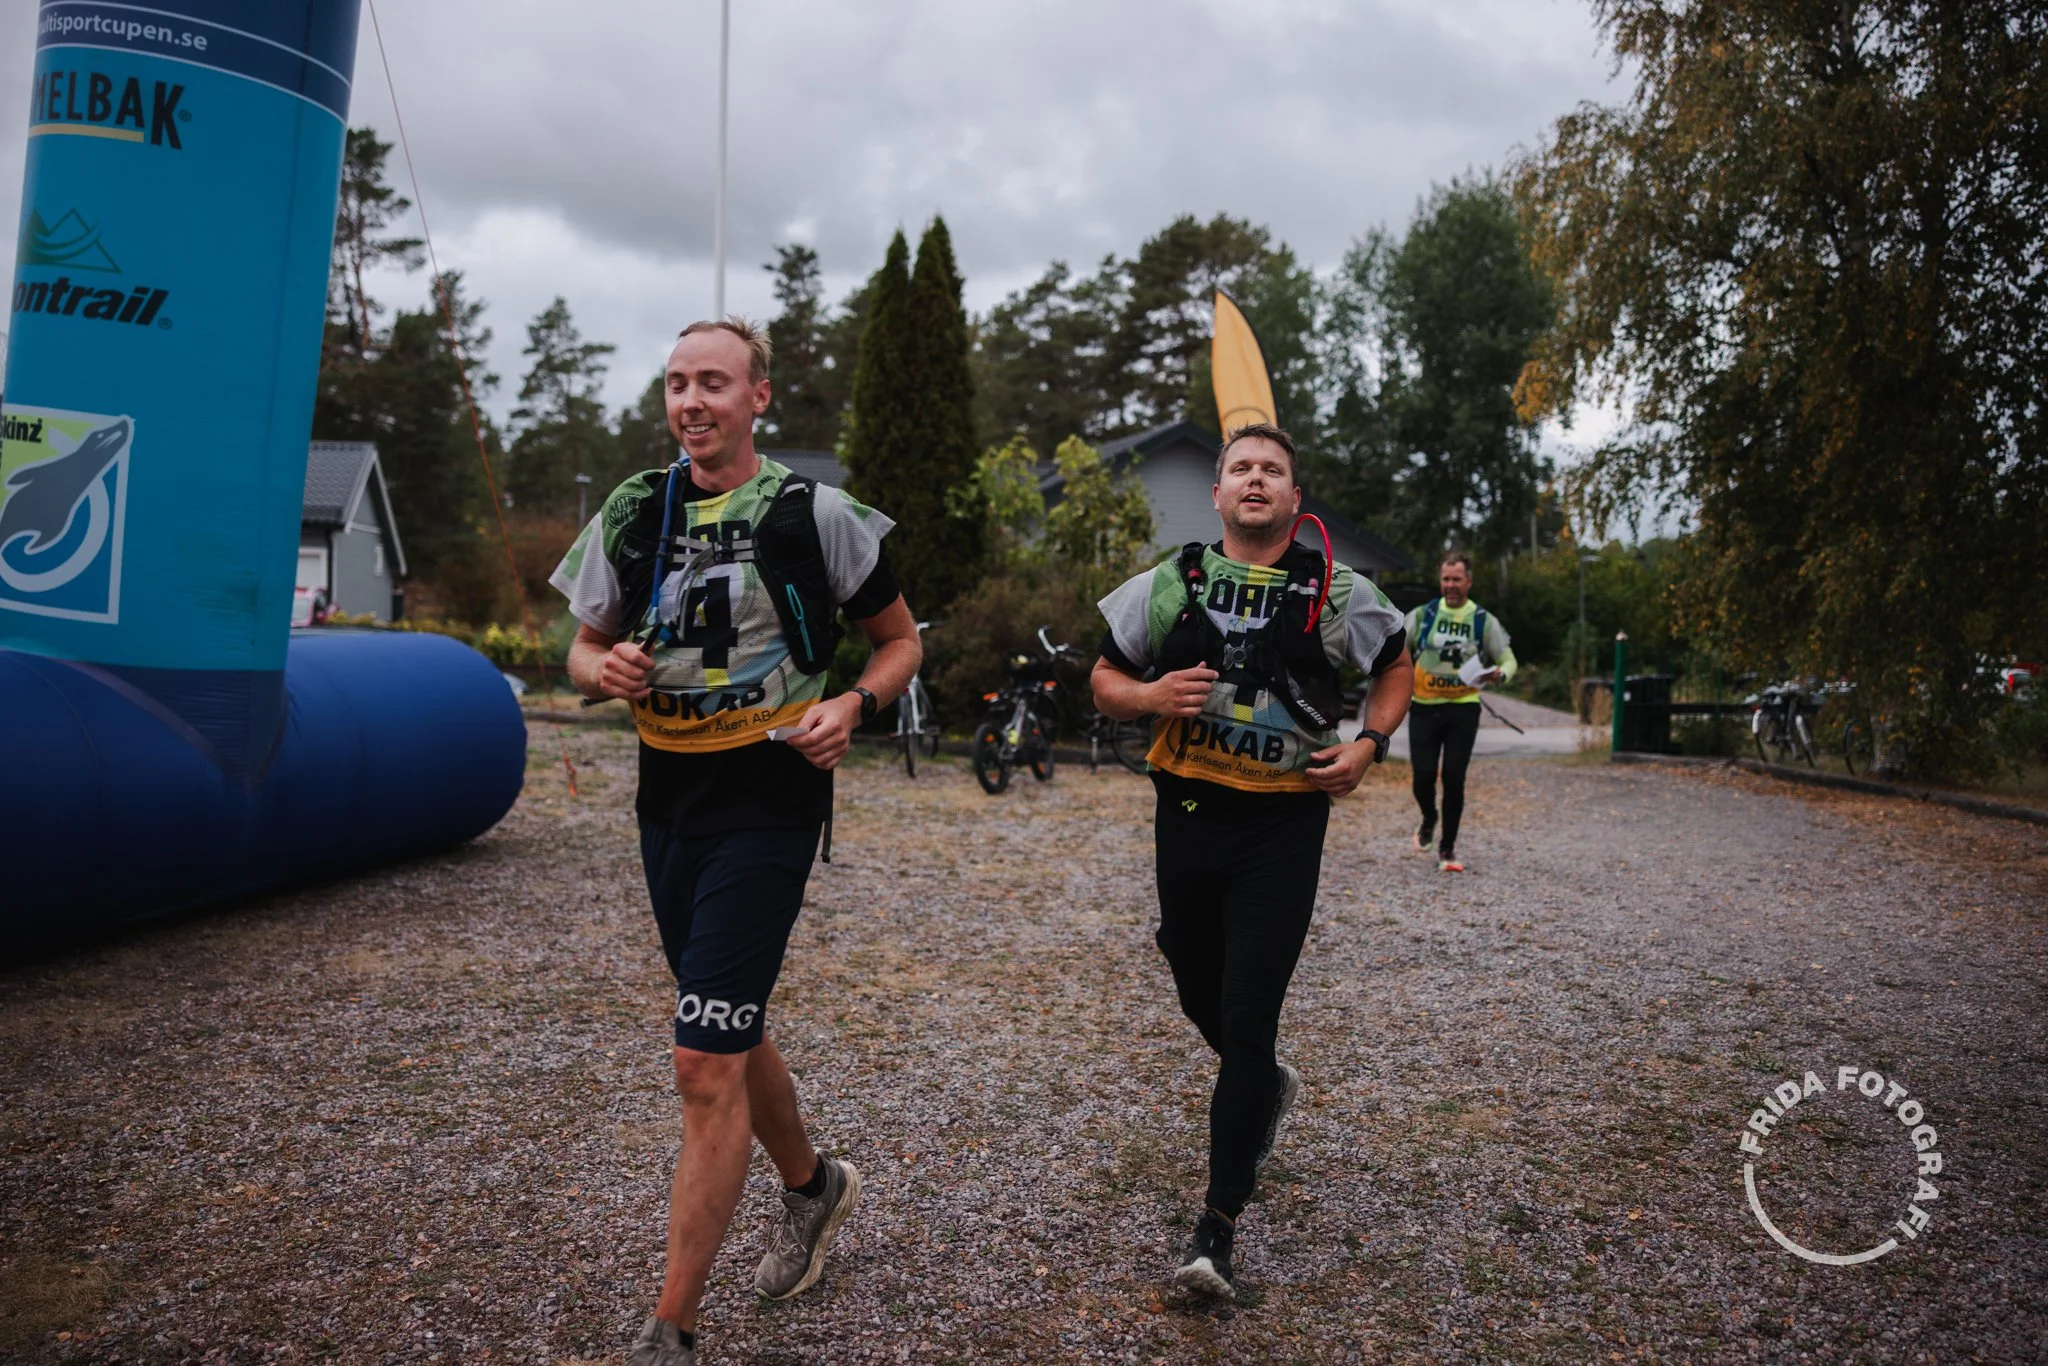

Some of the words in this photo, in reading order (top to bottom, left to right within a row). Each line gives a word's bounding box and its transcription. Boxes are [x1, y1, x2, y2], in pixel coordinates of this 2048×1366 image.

[715, 716, 748, 733] Åkeri
[752, 710, 771, 726] AB
[1296, 699, 1328, 727] USWE
[1235, 761, 1262, 778] Åkeri
[1264, 769, 1281, 780] AB
[676, 991, 760, 1031] ORG
